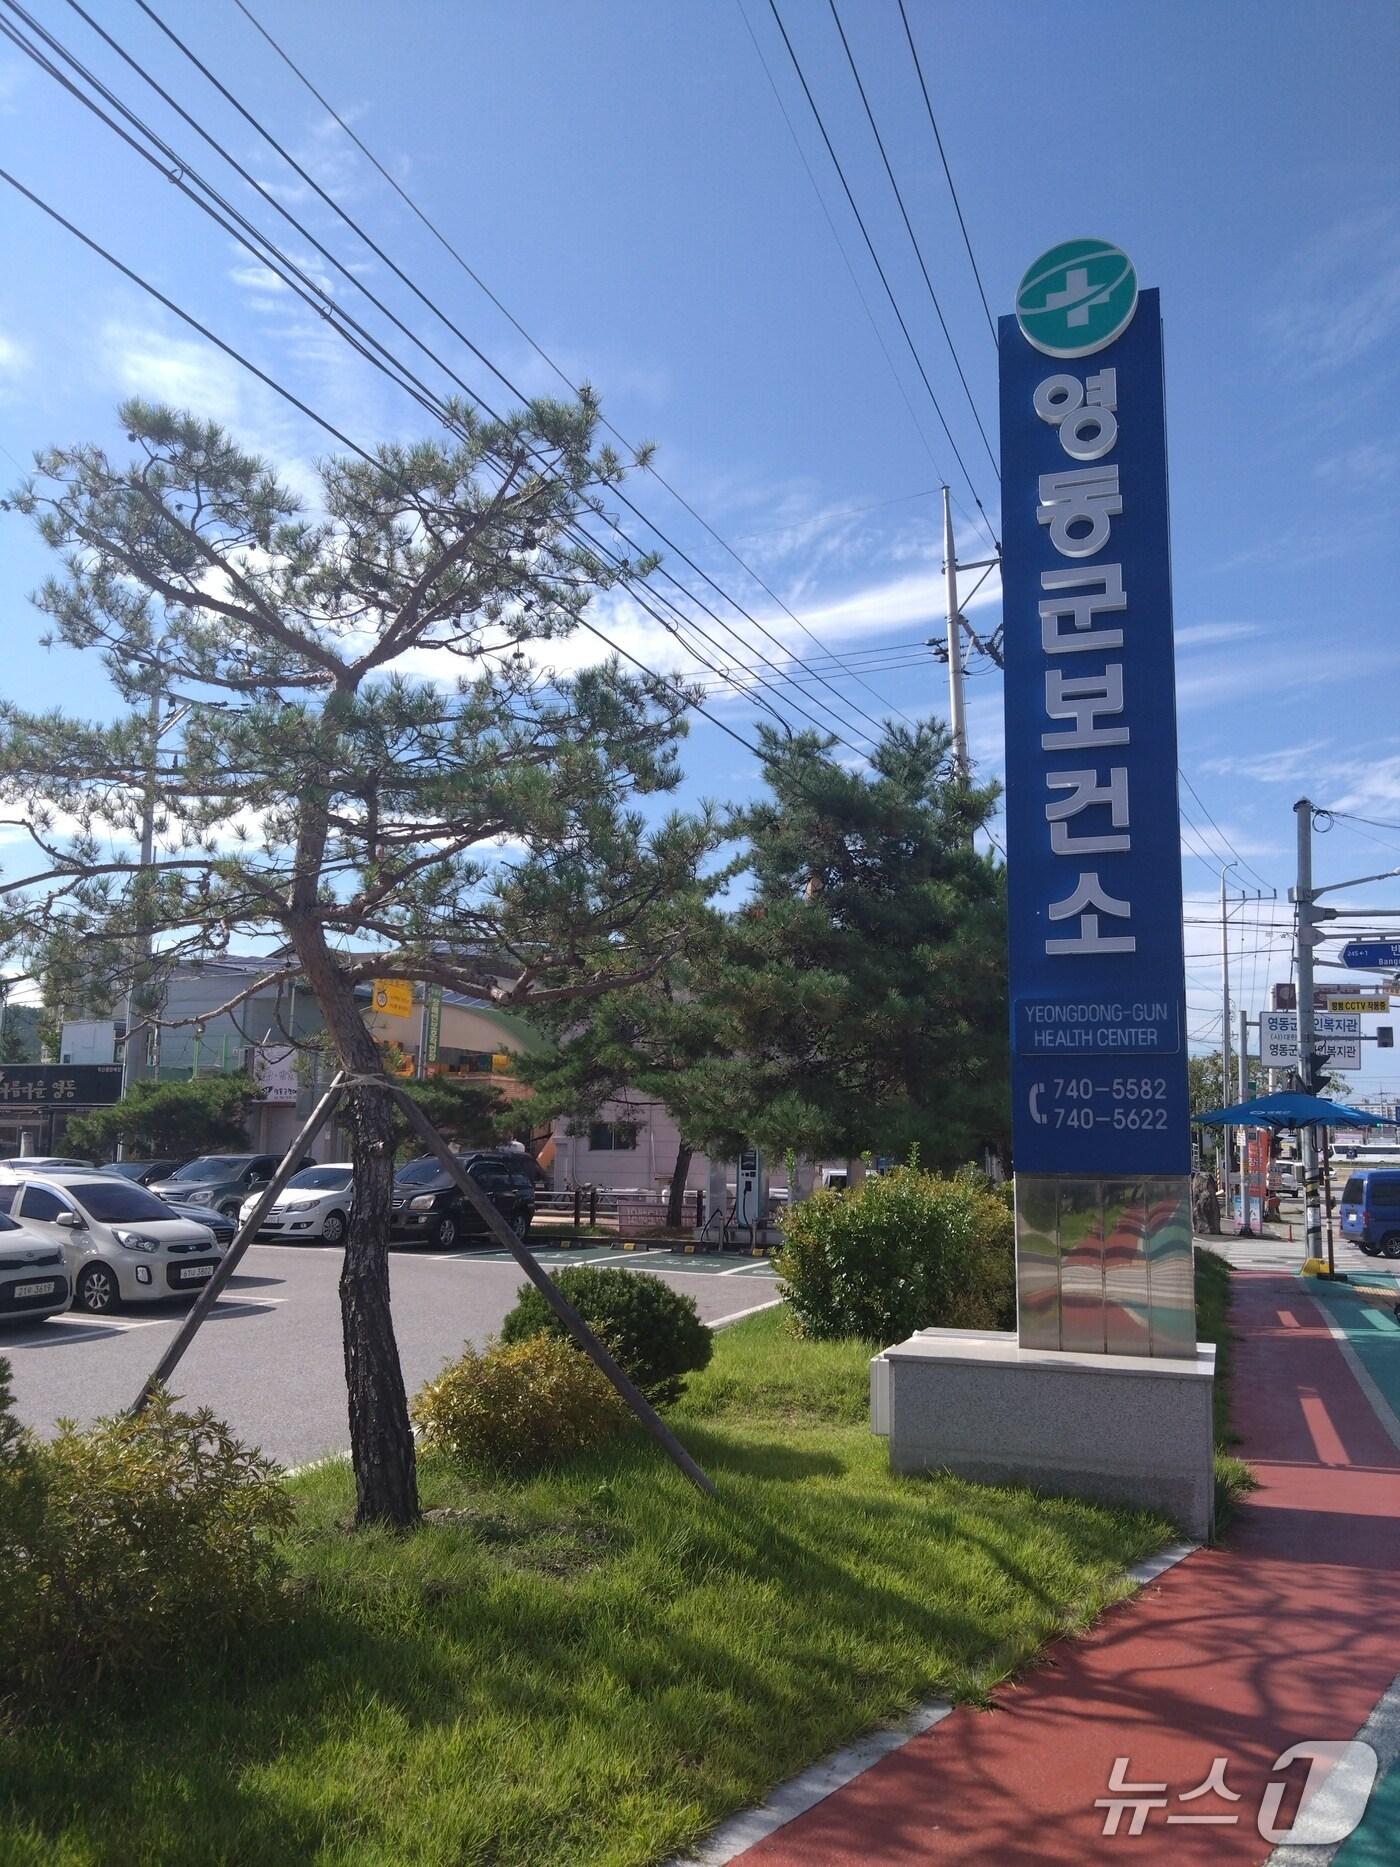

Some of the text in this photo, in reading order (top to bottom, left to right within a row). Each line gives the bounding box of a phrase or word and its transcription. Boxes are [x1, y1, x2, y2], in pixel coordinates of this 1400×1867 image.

[1033, 367, 1136, 955] 영동군보건소
[1025, 1003, 1168, 1023] YEONGDONG-GUN
[1345, 1001, 1366, 1011] CCTV
[1034, 1028, 1158, 1047] HEALTH CENTER
[52, 1079, 77, 1099] 영동
[1053, 1078, 1168, 1100] 740-5582
[1053, 1108, 1169, 1130] 740-5622
